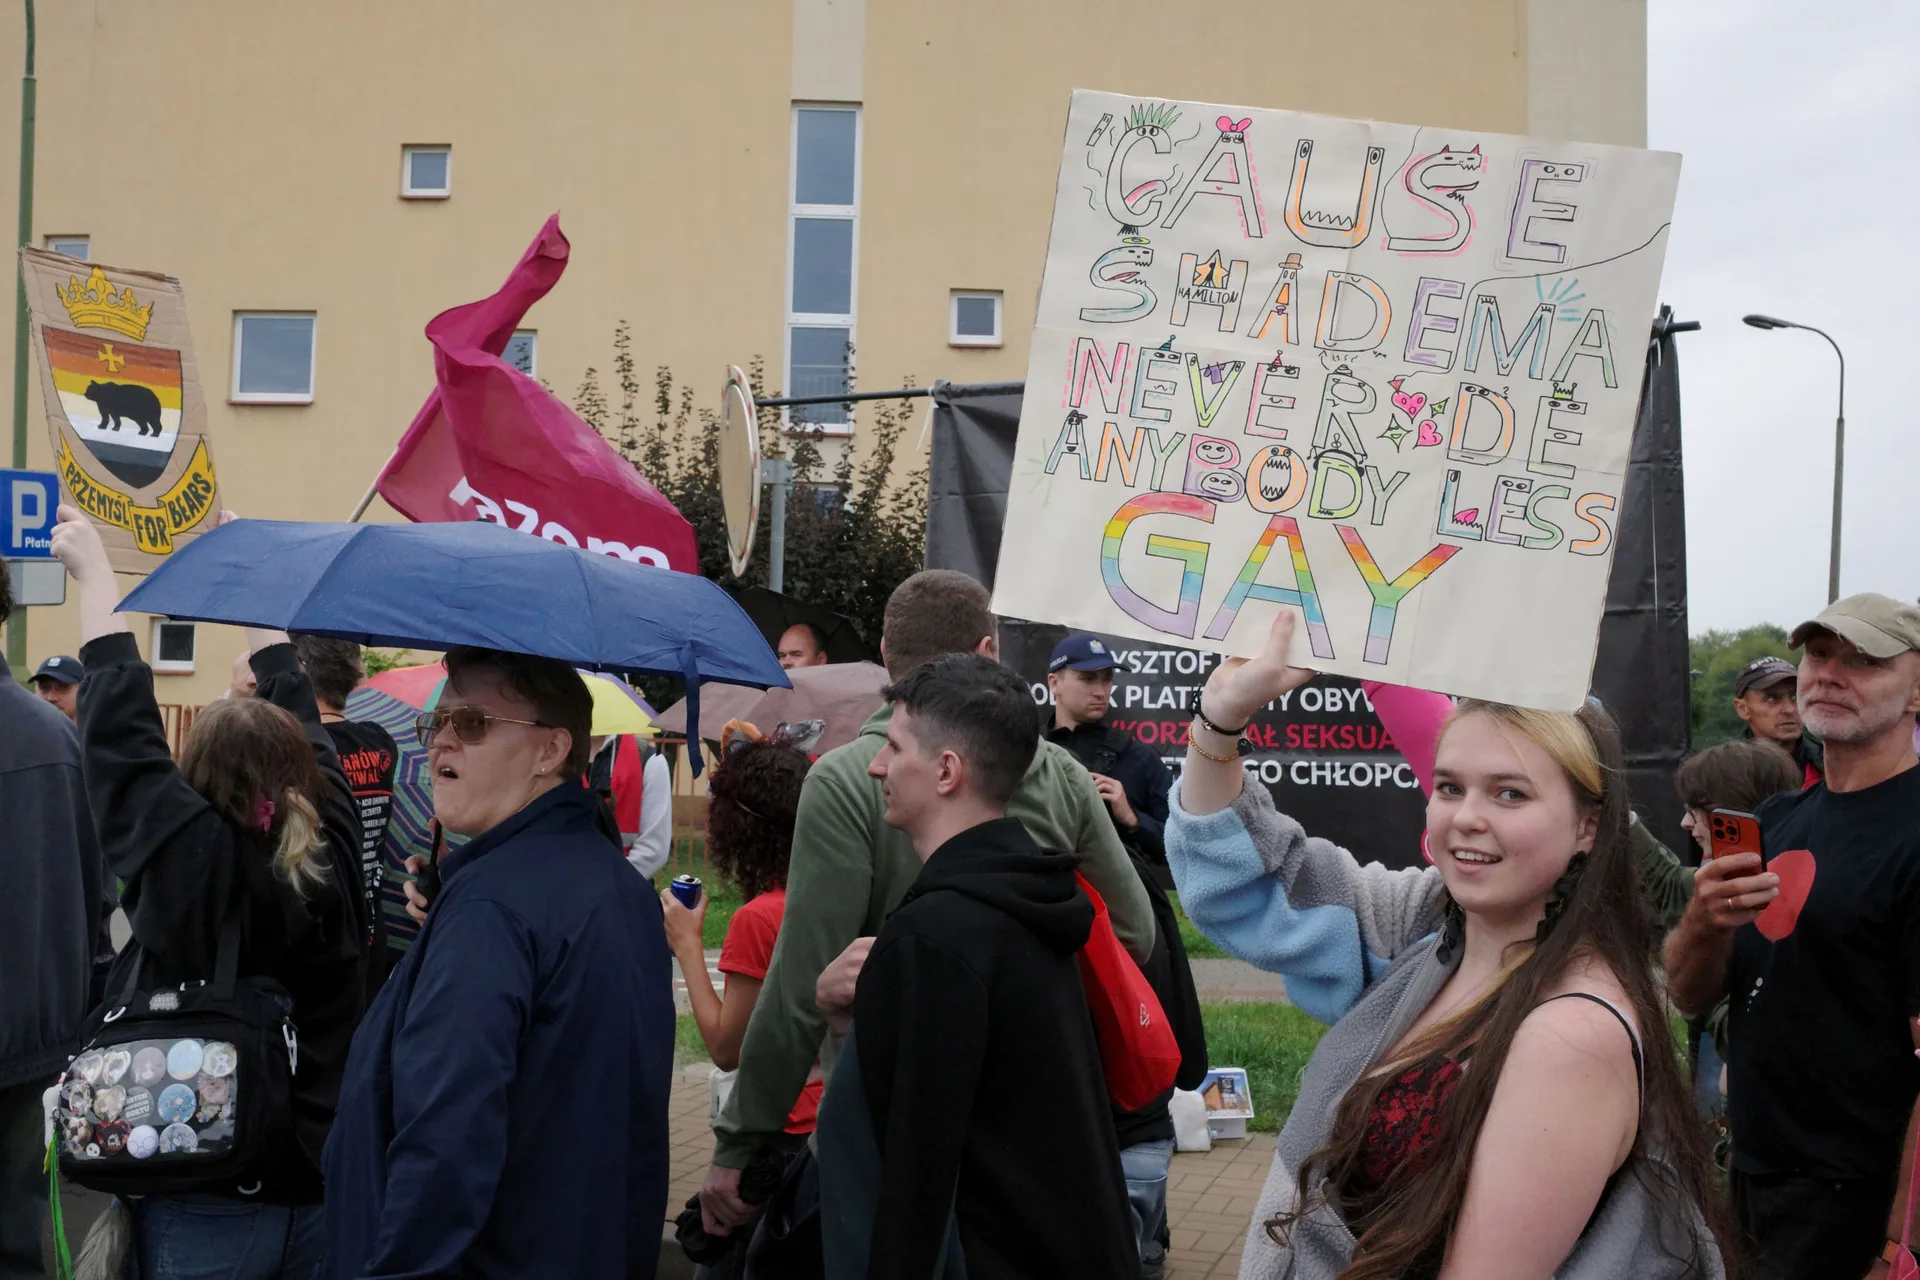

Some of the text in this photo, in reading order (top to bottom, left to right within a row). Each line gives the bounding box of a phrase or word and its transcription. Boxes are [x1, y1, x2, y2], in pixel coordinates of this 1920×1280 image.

[1178, 287, 1239, 304] HAMILTON
[1067, 336, 1377, 460] NEVER
[12, 480, 47, 548] P
[133, 513, 170, 548] FOR
[166, 471, 212, 529] BEARS
[1044, 411, 1617, 556] ANYBODY LESS
[1100, 491, 1464, 666] GAY
[1109, 650, 1213, 674] YSZTOF
[337, 747, 380, 771] ANÓW
[1290, 760, 1420, 788] CHŁOPC
